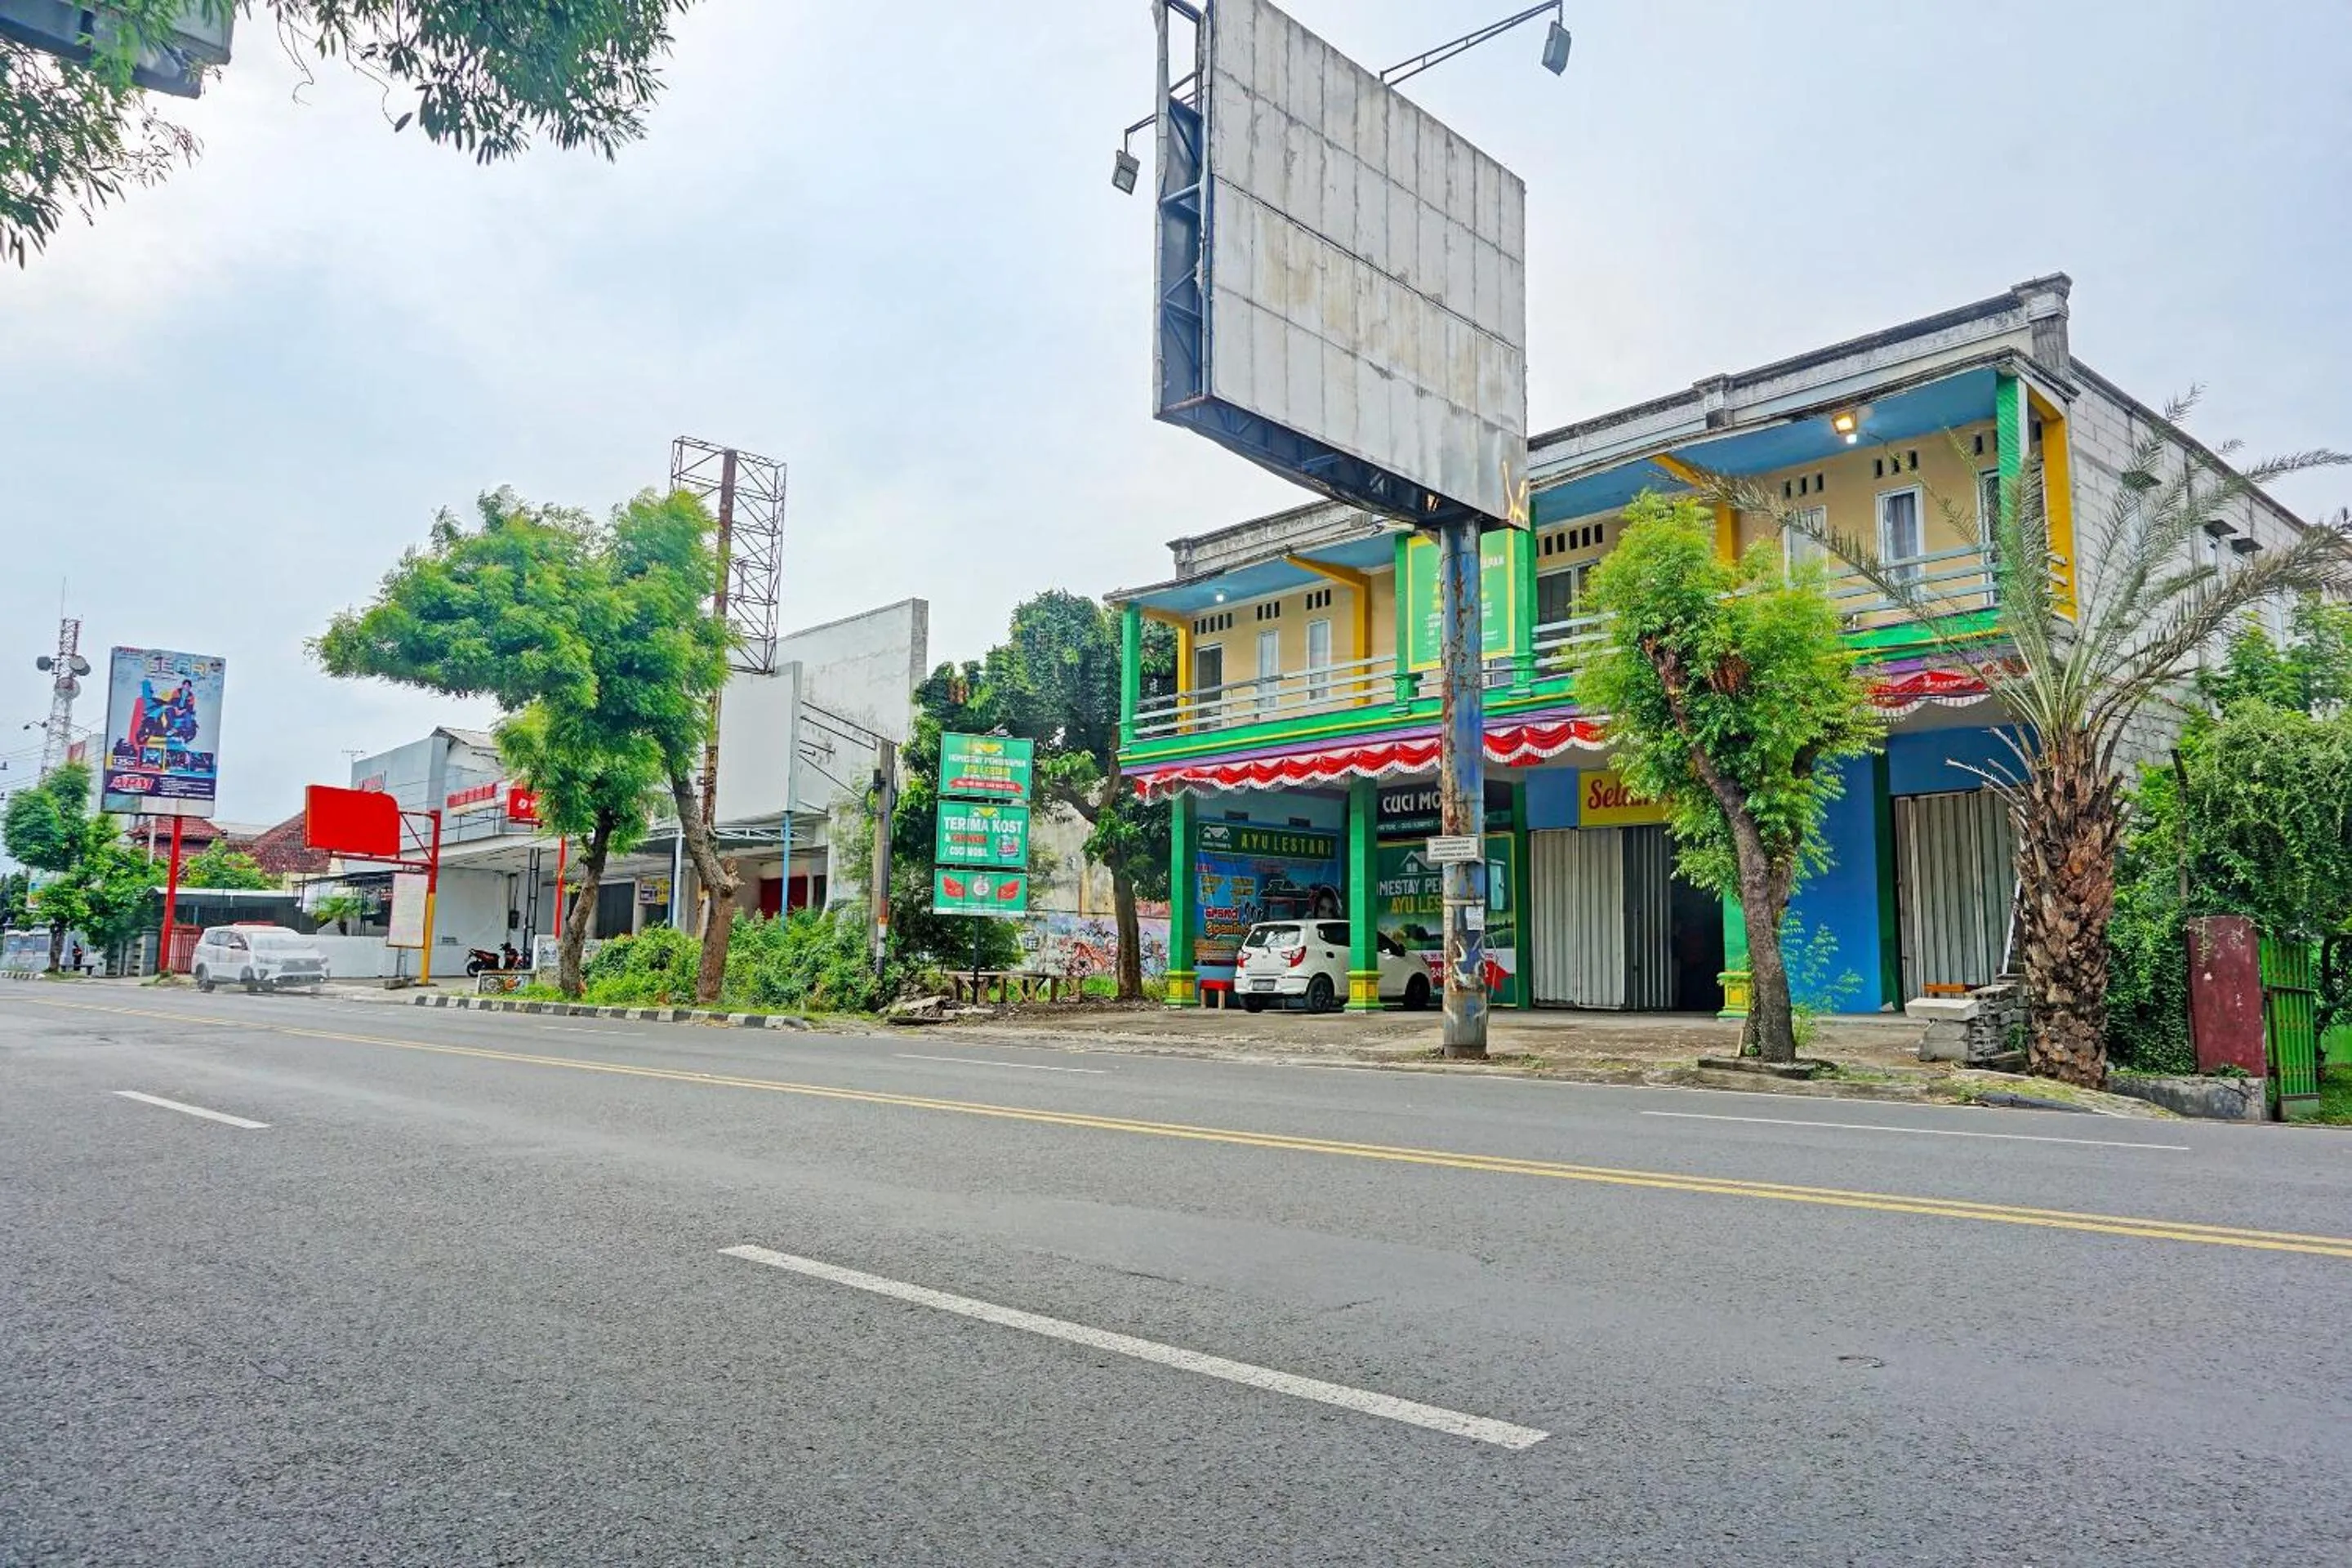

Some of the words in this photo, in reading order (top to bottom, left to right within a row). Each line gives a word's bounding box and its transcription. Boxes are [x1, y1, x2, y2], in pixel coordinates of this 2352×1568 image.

[1588, 777, 1656, 809] Sela
[1383, 794, 1414, 813] CUCI
[943, 817, 989, 832] TERIMA
[991, 819, 1023, 834] KOST
[1241, 833, 1268, 850] AYU
[1273, 834, 1332, 856] LESTARI
[1378, 878, 1419, 896] MESTAY
[1391, 896, 1414, 915] AYU
